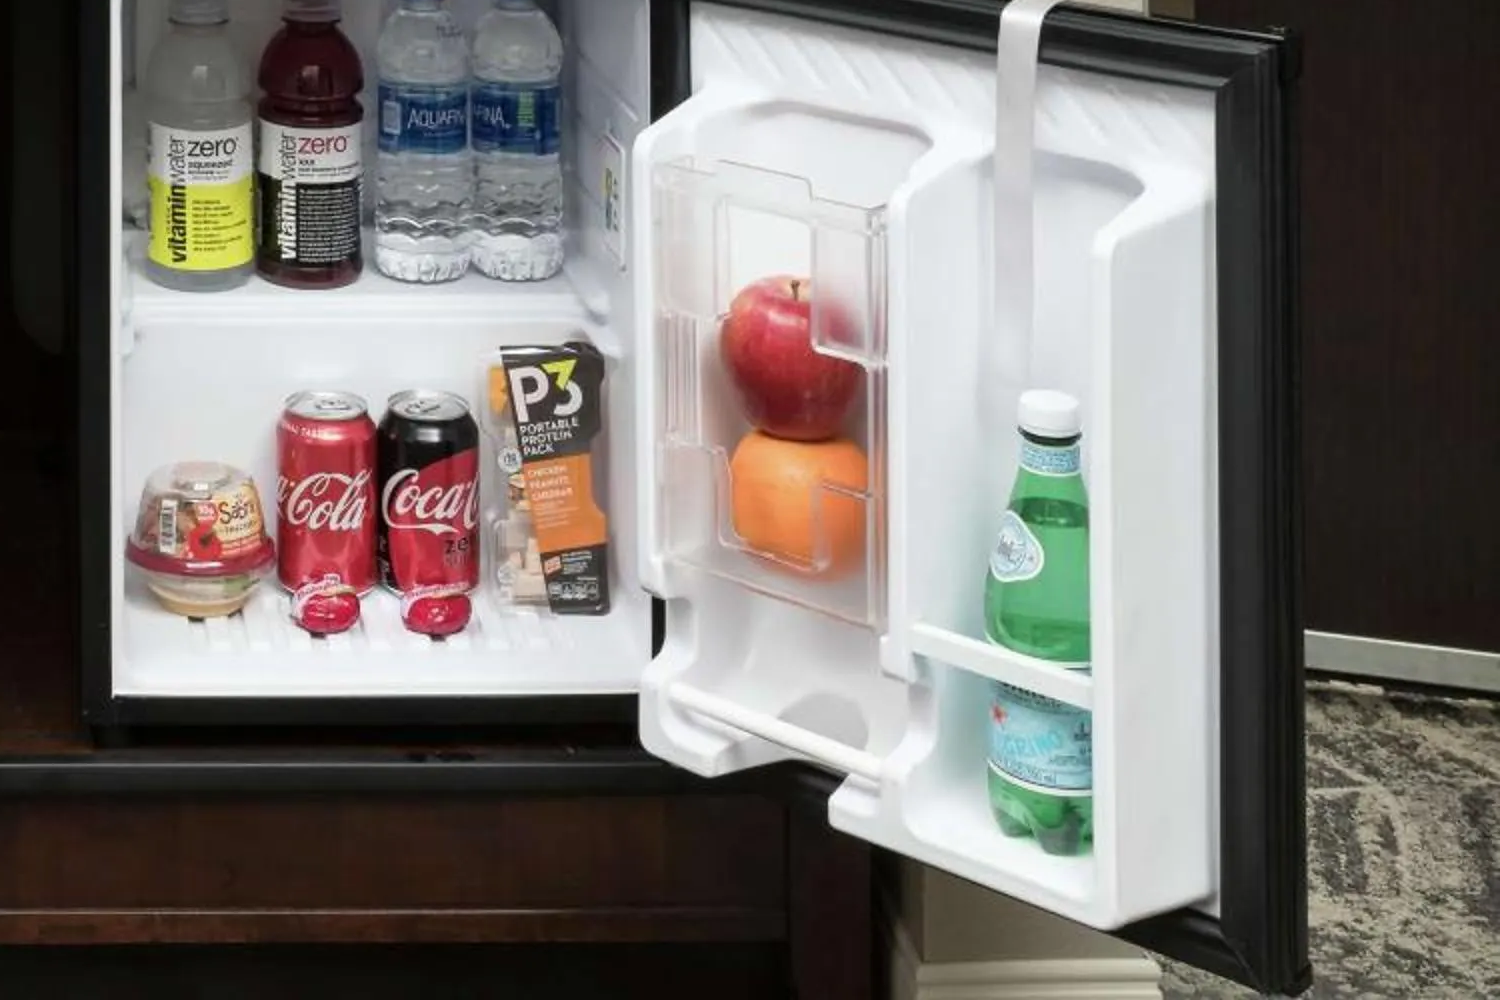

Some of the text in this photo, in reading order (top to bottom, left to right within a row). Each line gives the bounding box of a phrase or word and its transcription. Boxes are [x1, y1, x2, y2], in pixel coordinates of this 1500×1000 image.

[188, 138, 237, 157] zero
[298, 135, 347, 154] zero
[508, 359, 583, 422] P3
[520, 417, 579, 435] PORTABLE
[522, 430, 572, 446] PROTEIN
[524, 443, 555, 456] PACK
